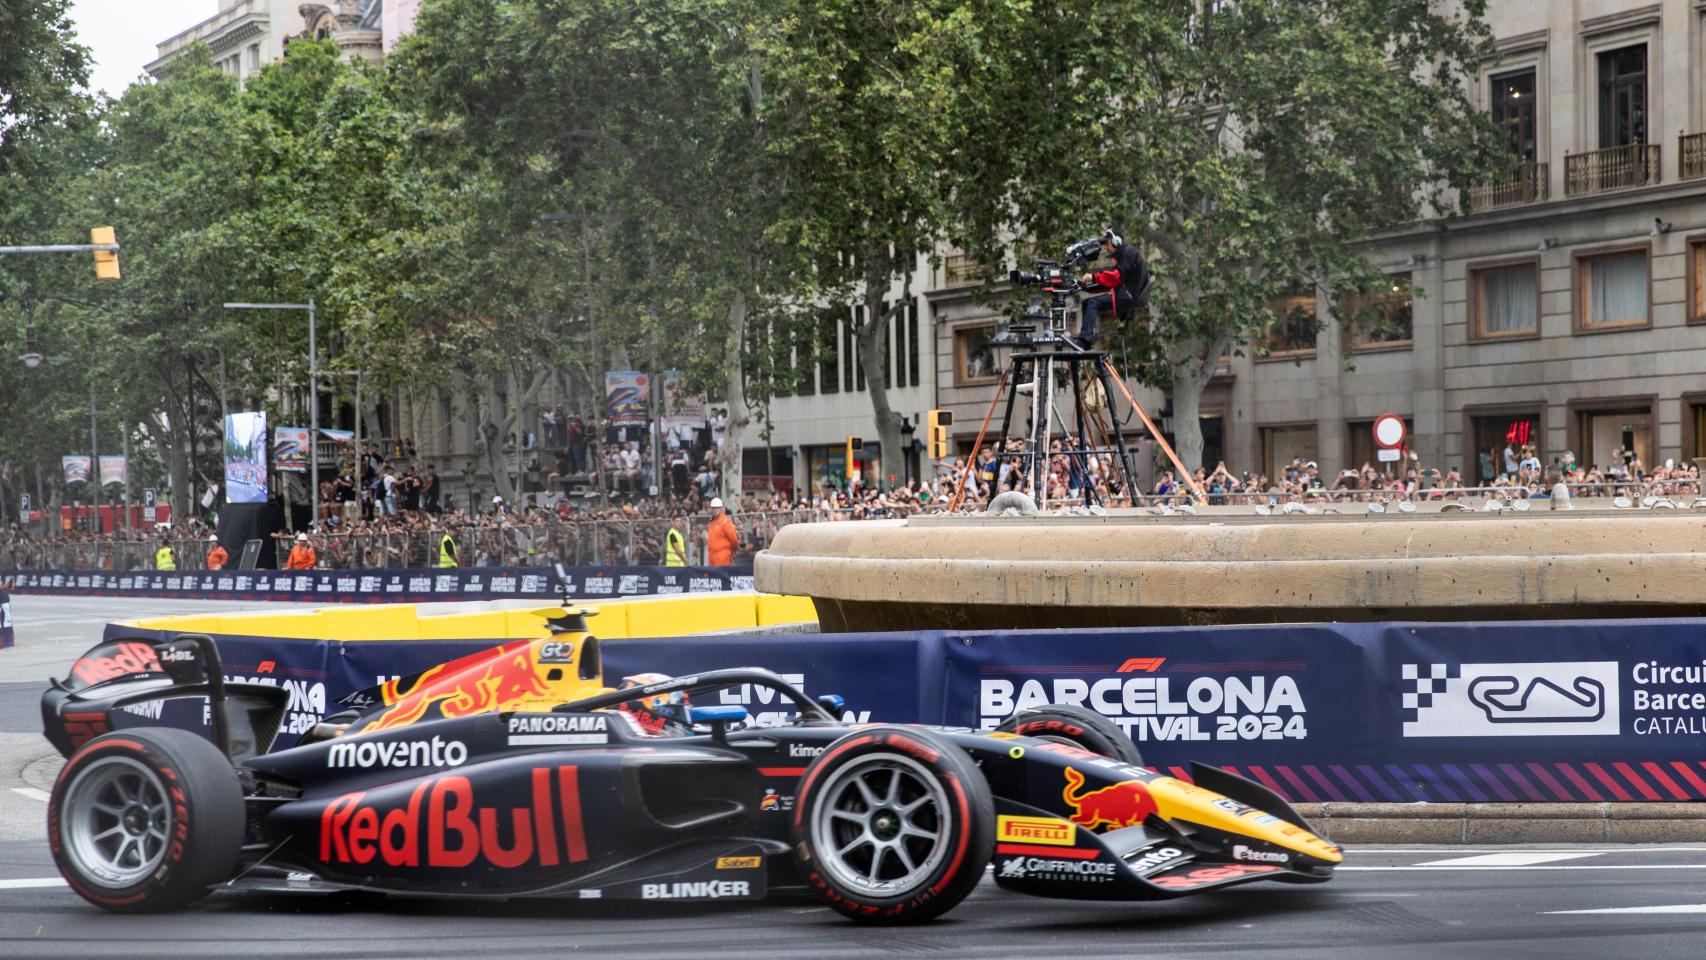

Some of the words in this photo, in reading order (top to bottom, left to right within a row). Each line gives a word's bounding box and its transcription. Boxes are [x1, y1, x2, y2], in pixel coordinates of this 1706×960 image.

[980, 675, 1307, 716] BARCELONA
[1633, 689, 1706, 710] Barce
[508, 716, 608, 733] PANORAMA
[1216, 714, 1308, 741] 2024
[327, 735, 468, 768] movento
[1005, 820, 1069, 840] PIRELLI
[641, 880, 750, 899] BLINKER
